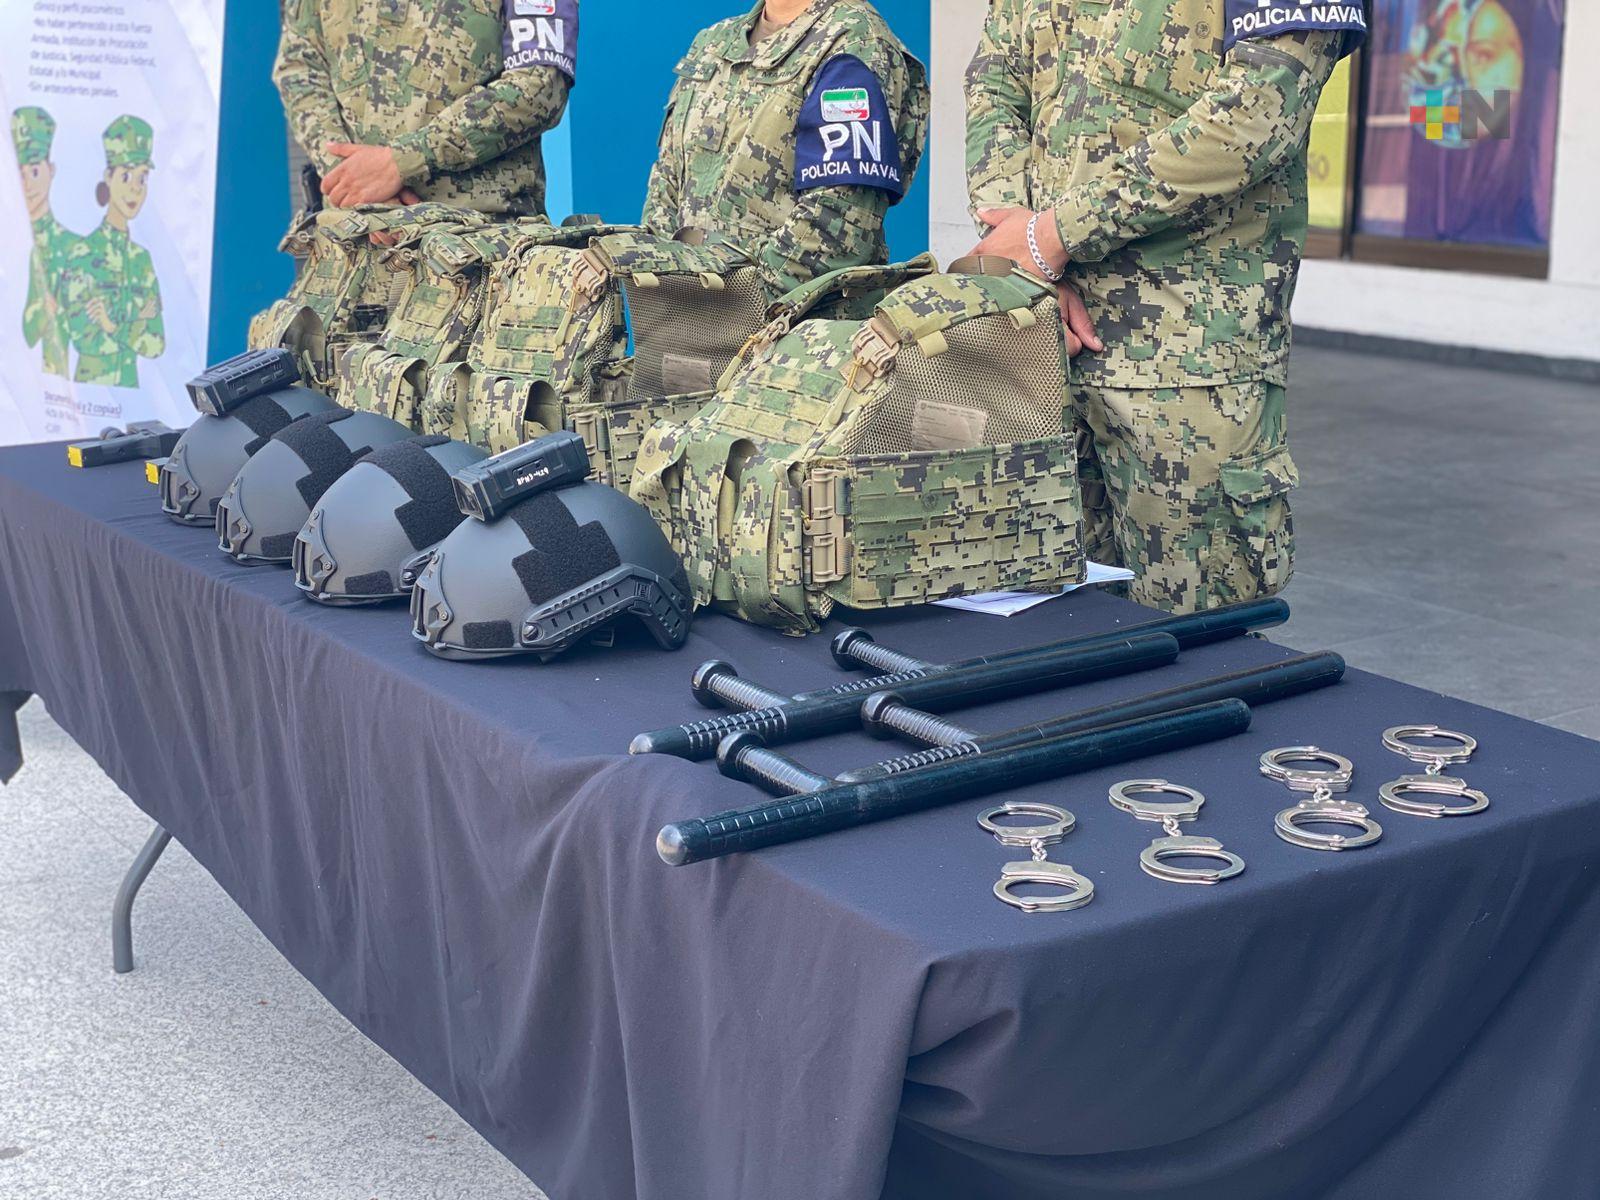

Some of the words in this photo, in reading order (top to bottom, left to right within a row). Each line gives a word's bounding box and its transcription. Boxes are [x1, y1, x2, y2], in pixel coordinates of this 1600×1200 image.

[509, 17, 564, 53] PN
[1232, 8, 1306, 36] POLICIA
[1312, 5, 1367, 28] NAVAL
[503, 49, 541, 70] POLICIA
[544, 51, 575, 75] NAVAL
[819, 120, 881, 162] PN
[801, 161, 852, 182] POLICIA
[859, 160, 900, 182] NAVAL
